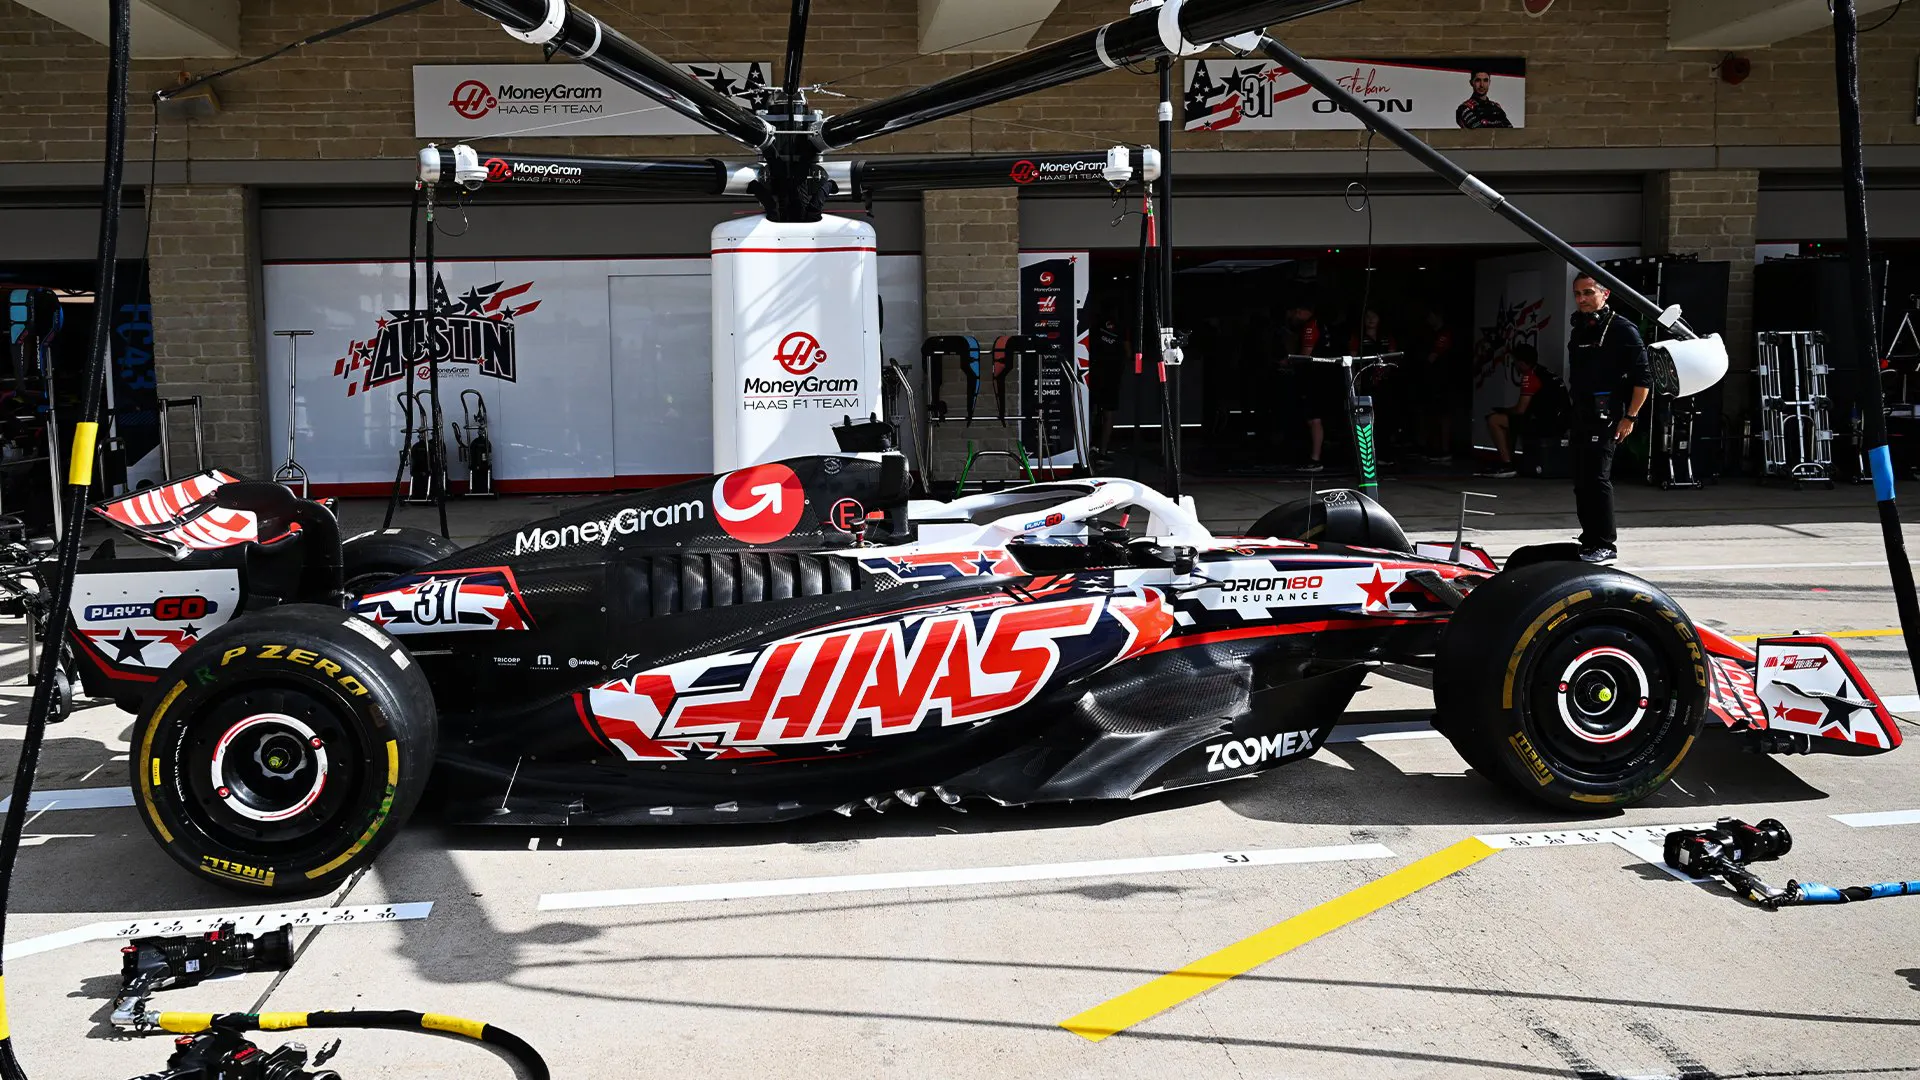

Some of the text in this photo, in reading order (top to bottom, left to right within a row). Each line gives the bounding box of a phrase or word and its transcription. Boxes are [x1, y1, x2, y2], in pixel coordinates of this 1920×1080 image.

[498, 84, 602, 102] MoneyGram
[1243, 75, 1272, 118] 31
[499, 105, 603, 114] HAAS F1 TEAM
[513, 162, 582, 176] MoneyGram
[1040, 161, 1107, 173] MoneyGram
[512, 175, 539, 183] HAAS
[369, 315, 517, 386] AUSTIN
[743, 376, 859, 397] MoneyGram
[744, 398, 859, 410] HAAS F1 TEAM
[839, 502, 856, 529] E
[1046, 513, 1062, 527] GO
[515, 500, 704, 555] MoneyGram
[1221, 575, 1323, 592] ORION180
[412, 577, 463, 626] 31
[1222, 591, 1319, 603] INSURANCE
[91, 597, 206, 620] PLAY'n GO
[220, 645, 370, 697] P ZERO
[578, 659, 600, 667] infobip
[657, 597, 1104, 746] HAAS
[1206, 728, 1319, 773] ZOOMEX
[1508, 730, 1554, 786] PIRELLI
[1510, 839, 1530, 847] 30
[1223, 854, 1250, 864] SJ
[116, 928, 140, 936] 30
[161, 925, 184, 933] 20
[294, 916, 310, 925] 10
[333, 914, 355, 922] 20
[375, 911, 396, 920] 30
